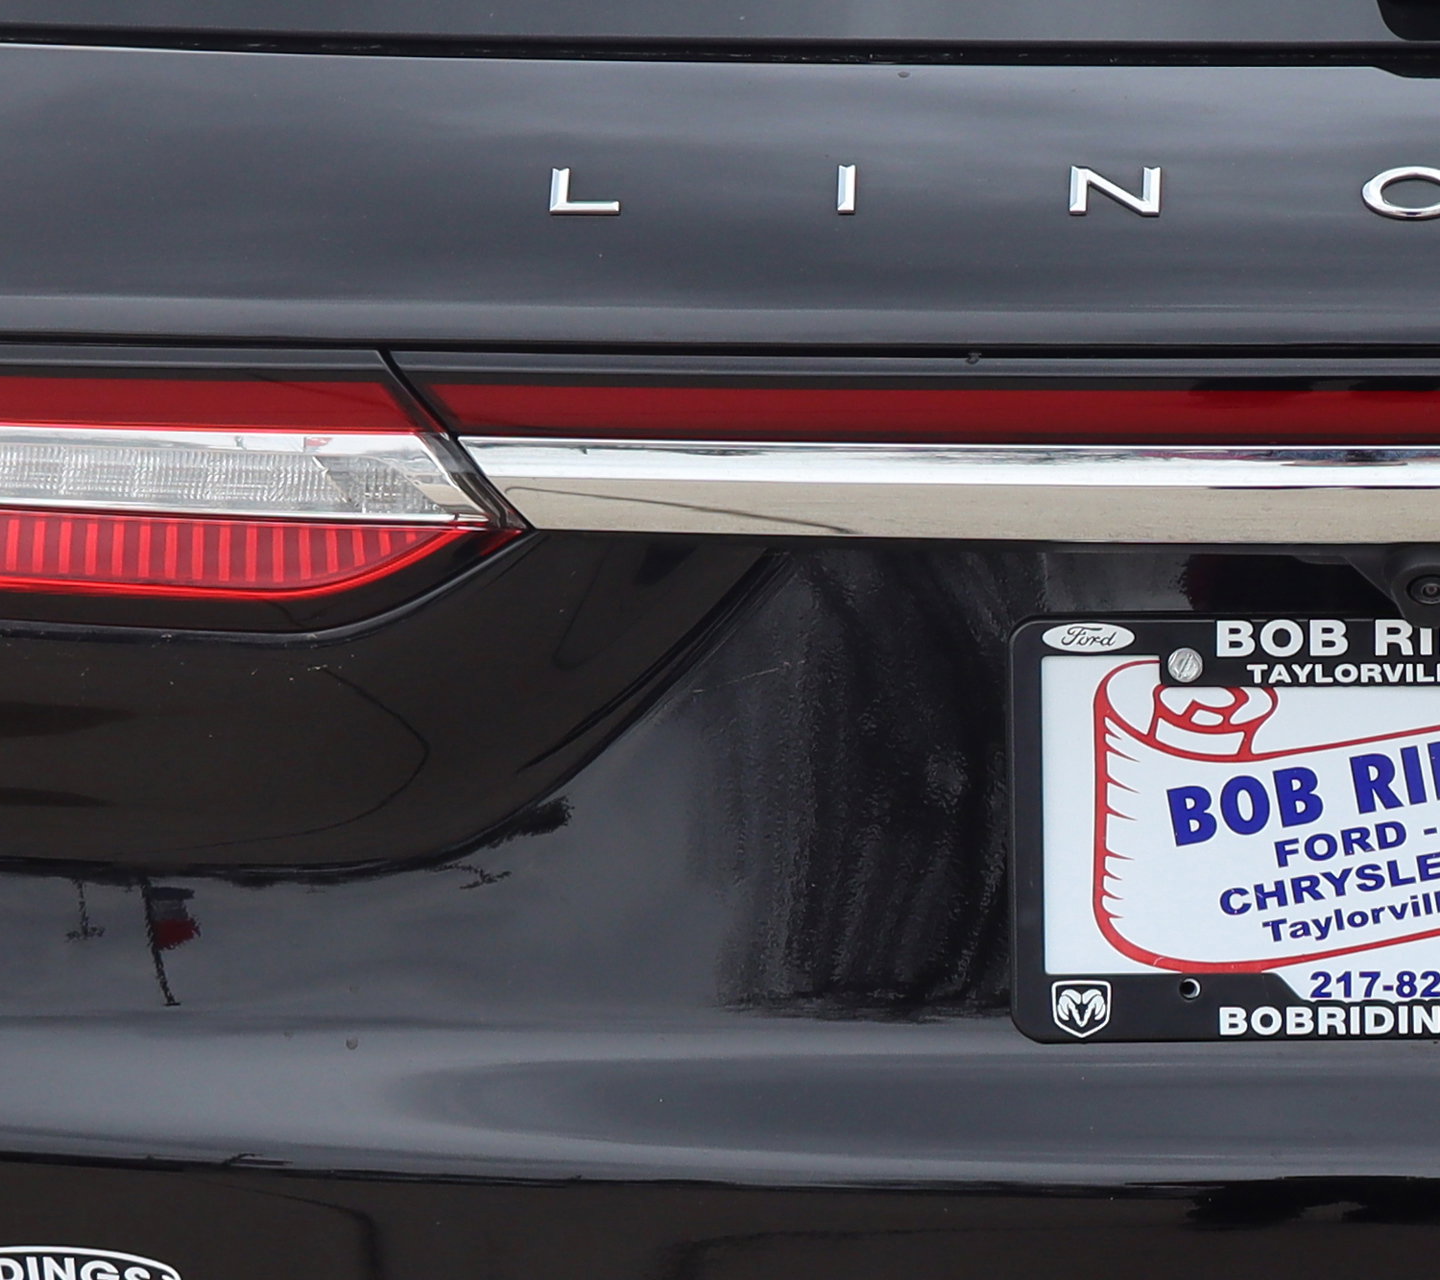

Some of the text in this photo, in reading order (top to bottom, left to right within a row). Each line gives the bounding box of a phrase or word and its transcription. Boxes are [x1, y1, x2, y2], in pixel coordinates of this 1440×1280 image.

[1060, 626, 1116, 649] Ford
[1215, 619, 1350, 658] BOB
[1165, 766, 1324, 848] BOB
[1273, 821, 1408, 869] FORD
